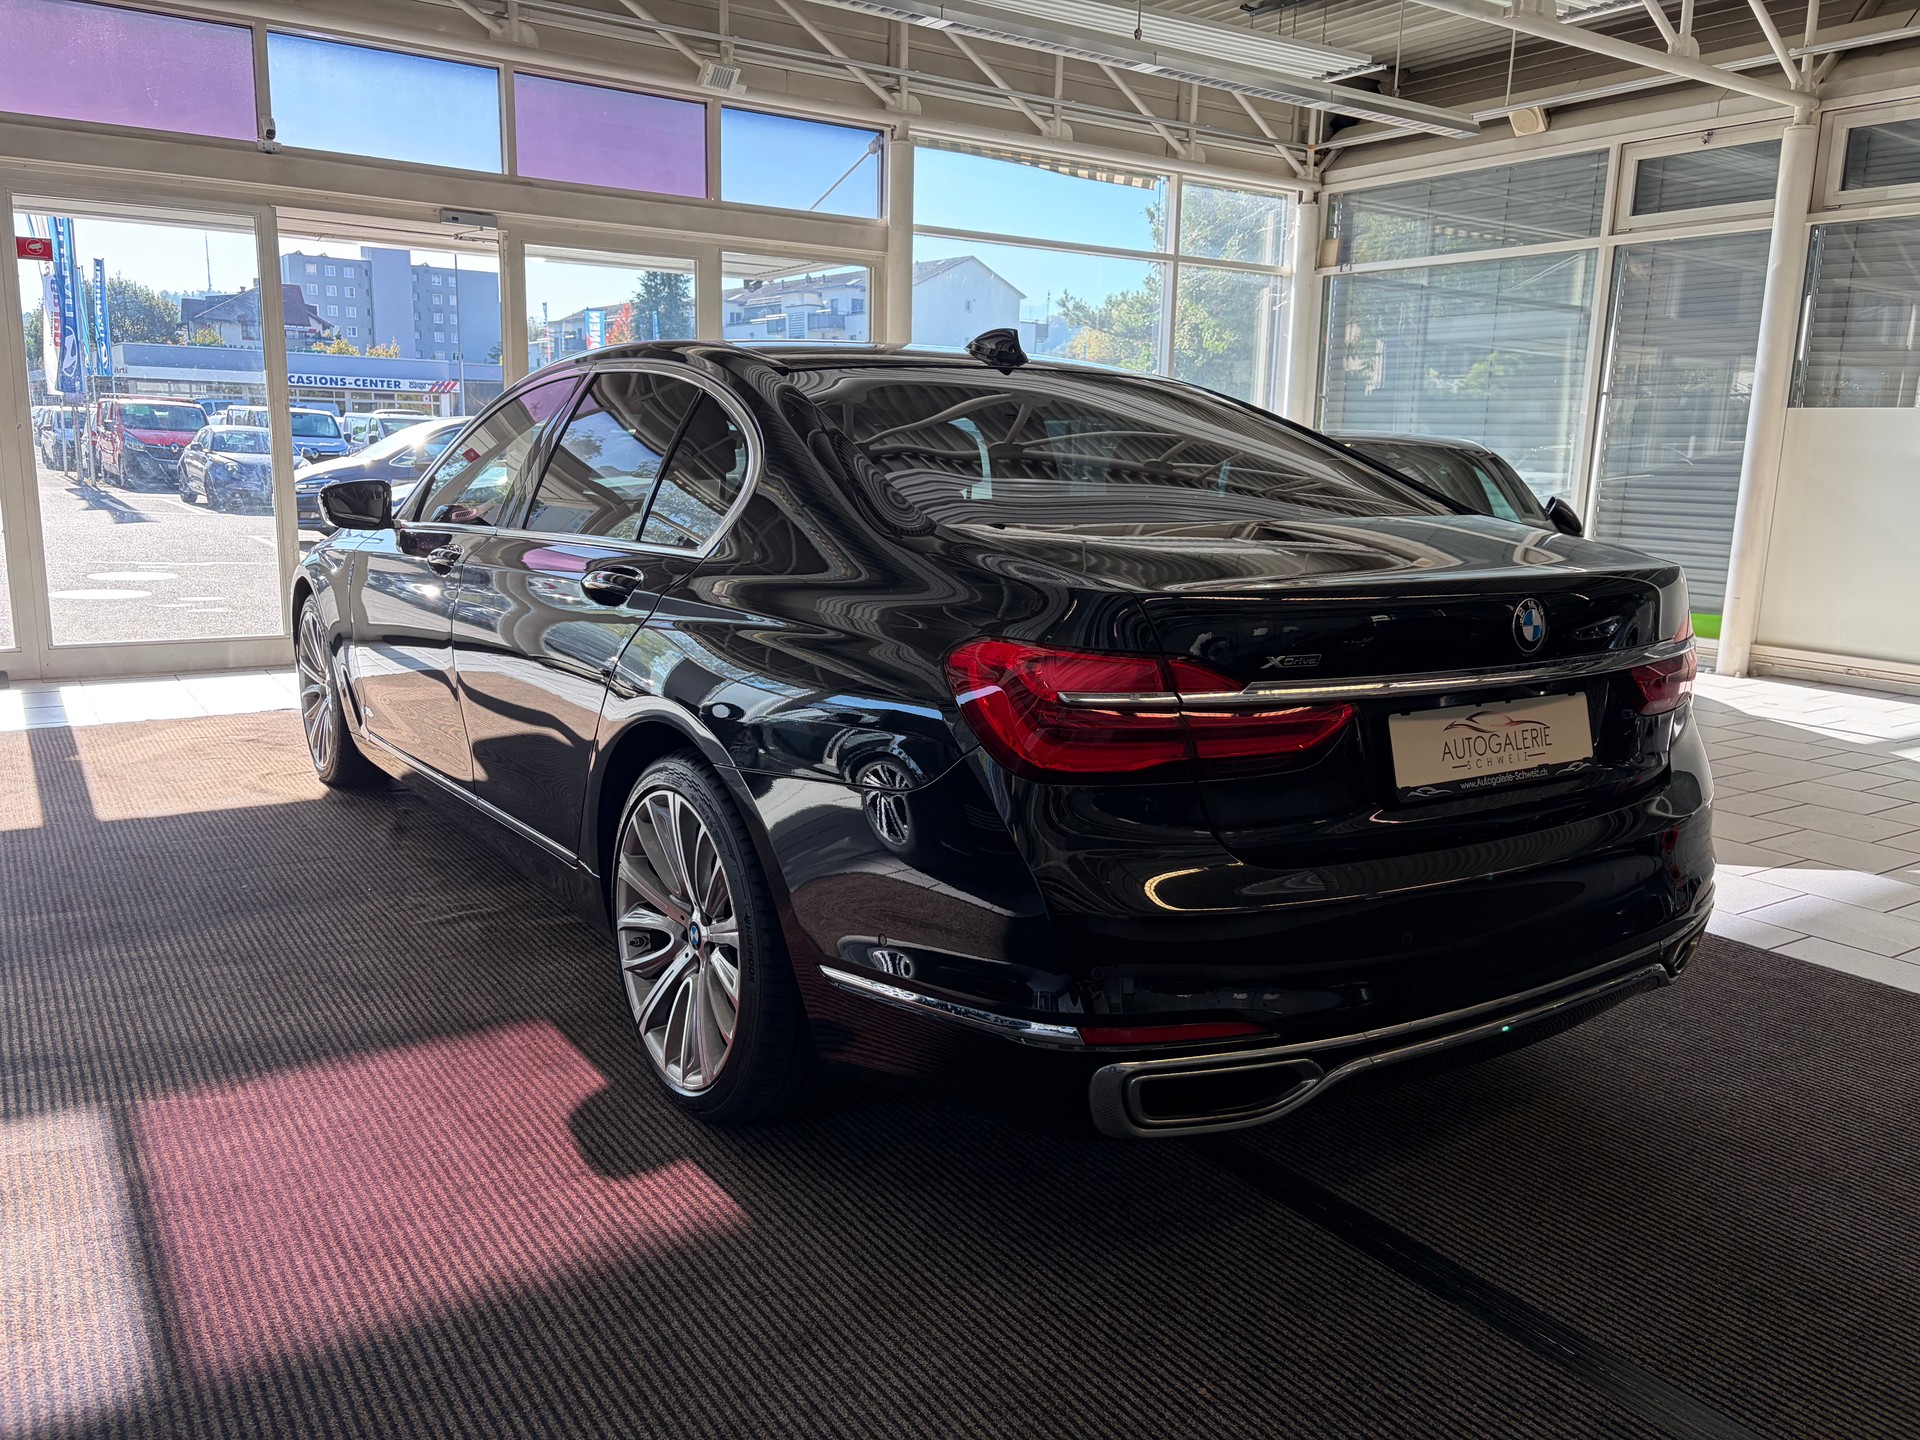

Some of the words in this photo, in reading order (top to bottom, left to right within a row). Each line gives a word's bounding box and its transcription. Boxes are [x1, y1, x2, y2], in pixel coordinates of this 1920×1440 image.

[288, 374, 401, 389] CASIONS-CENTER
[1442, 726, 1553, 762] AUTOGALERIE
[1466, 752, 1529, 770] SCHWEIZ
[1460, 768, 1548, 790] www.Autogalerie-Schweiz.ch
